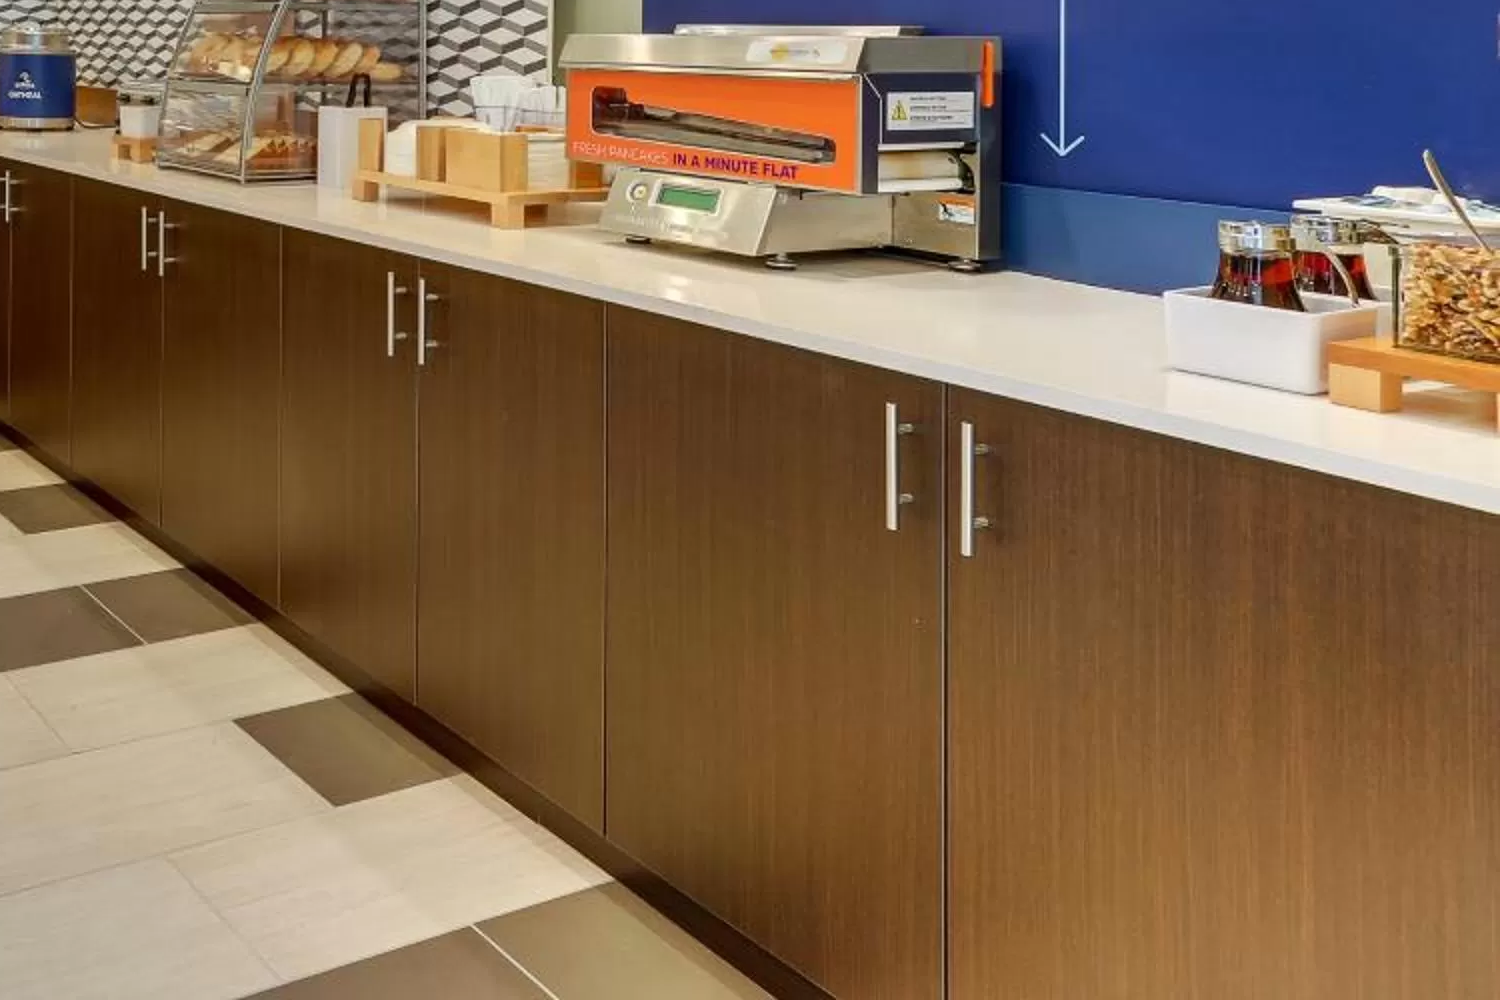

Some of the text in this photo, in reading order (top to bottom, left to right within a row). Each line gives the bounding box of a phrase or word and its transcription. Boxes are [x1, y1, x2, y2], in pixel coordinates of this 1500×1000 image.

[573, 141, 798, 180] FRESH PANCAKES IN A MINUTE FLAT
